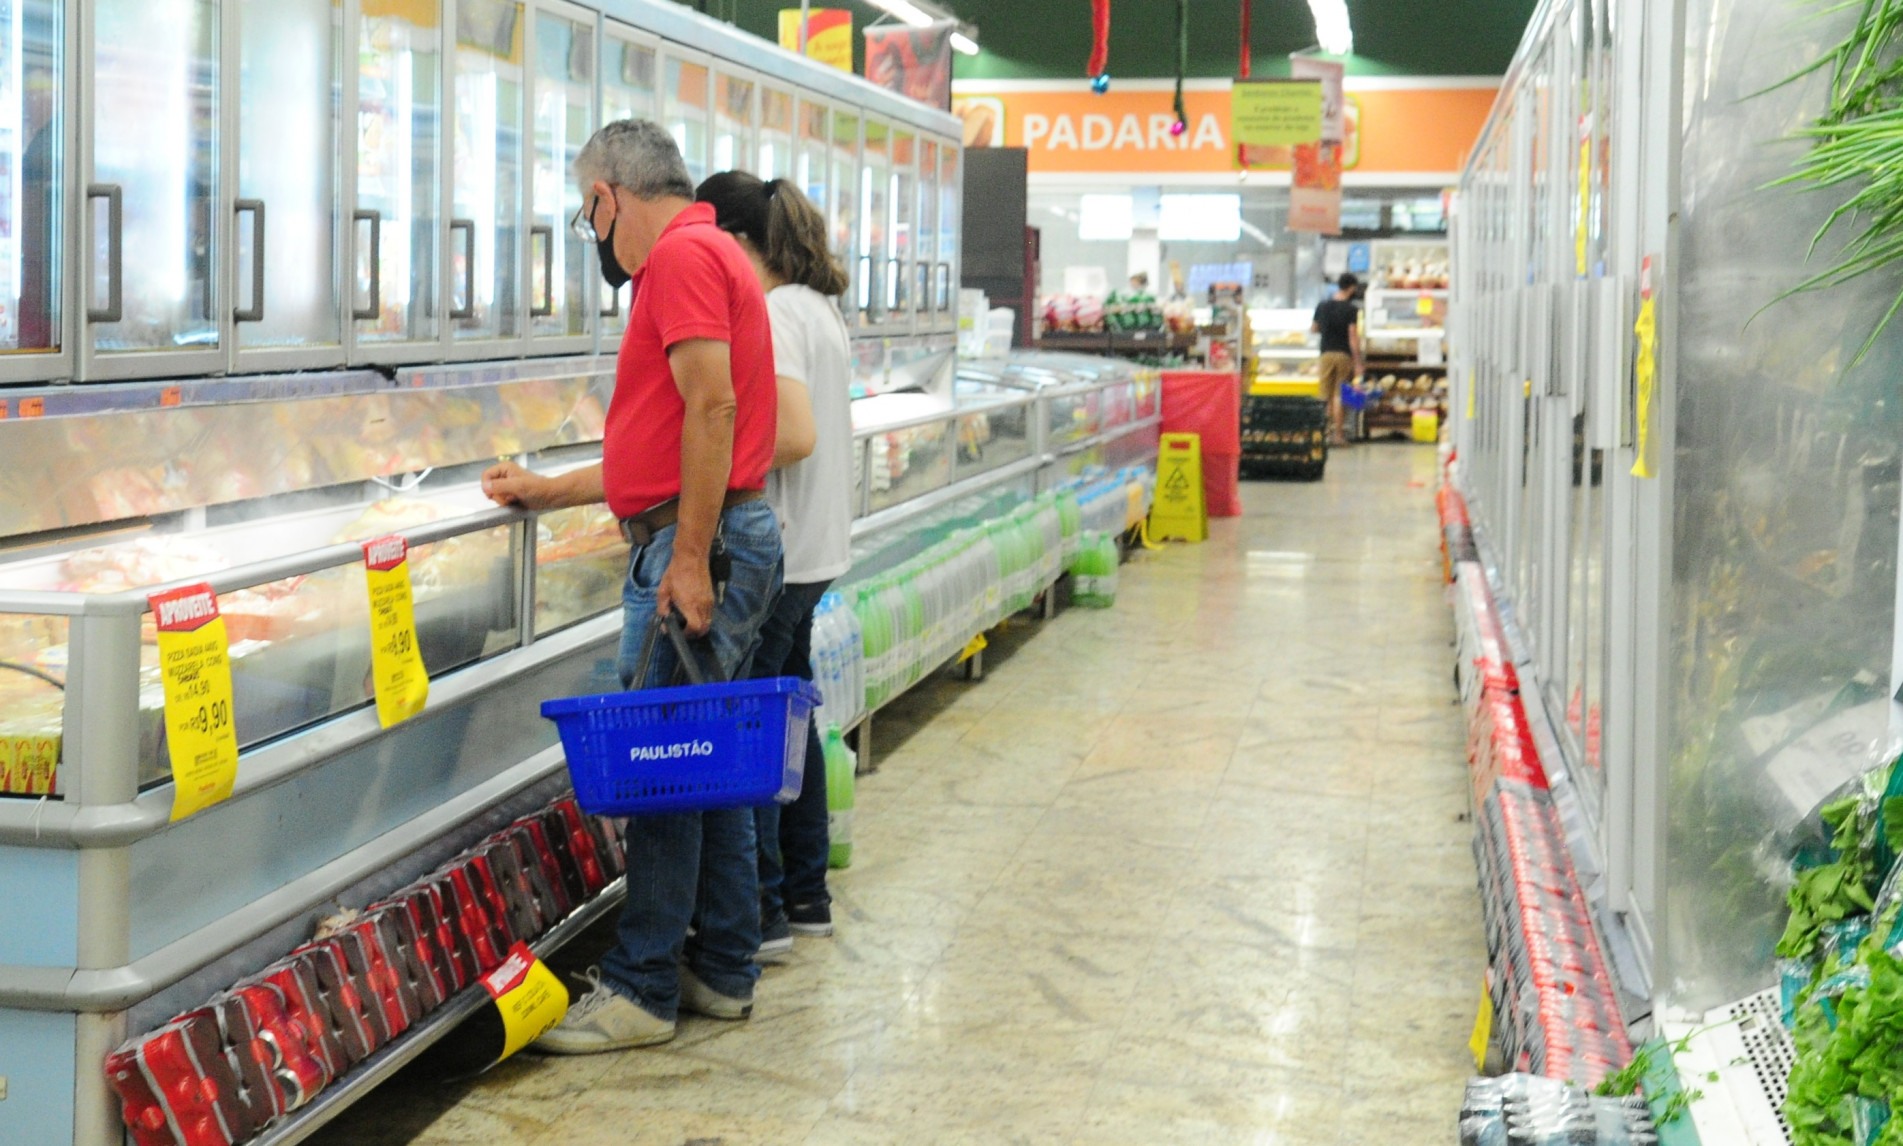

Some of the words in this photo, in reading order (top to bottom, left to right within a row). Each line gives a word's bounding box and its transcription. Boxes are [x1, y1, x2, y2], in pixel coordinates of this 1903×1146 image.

[1023, 113, 1225, 150] PADARIA
[159, 591, 216, 627] APROVEITE
[167, 649, 185, 663] PIZZA
[630, 738, 713, 762] PAULISTÃO
